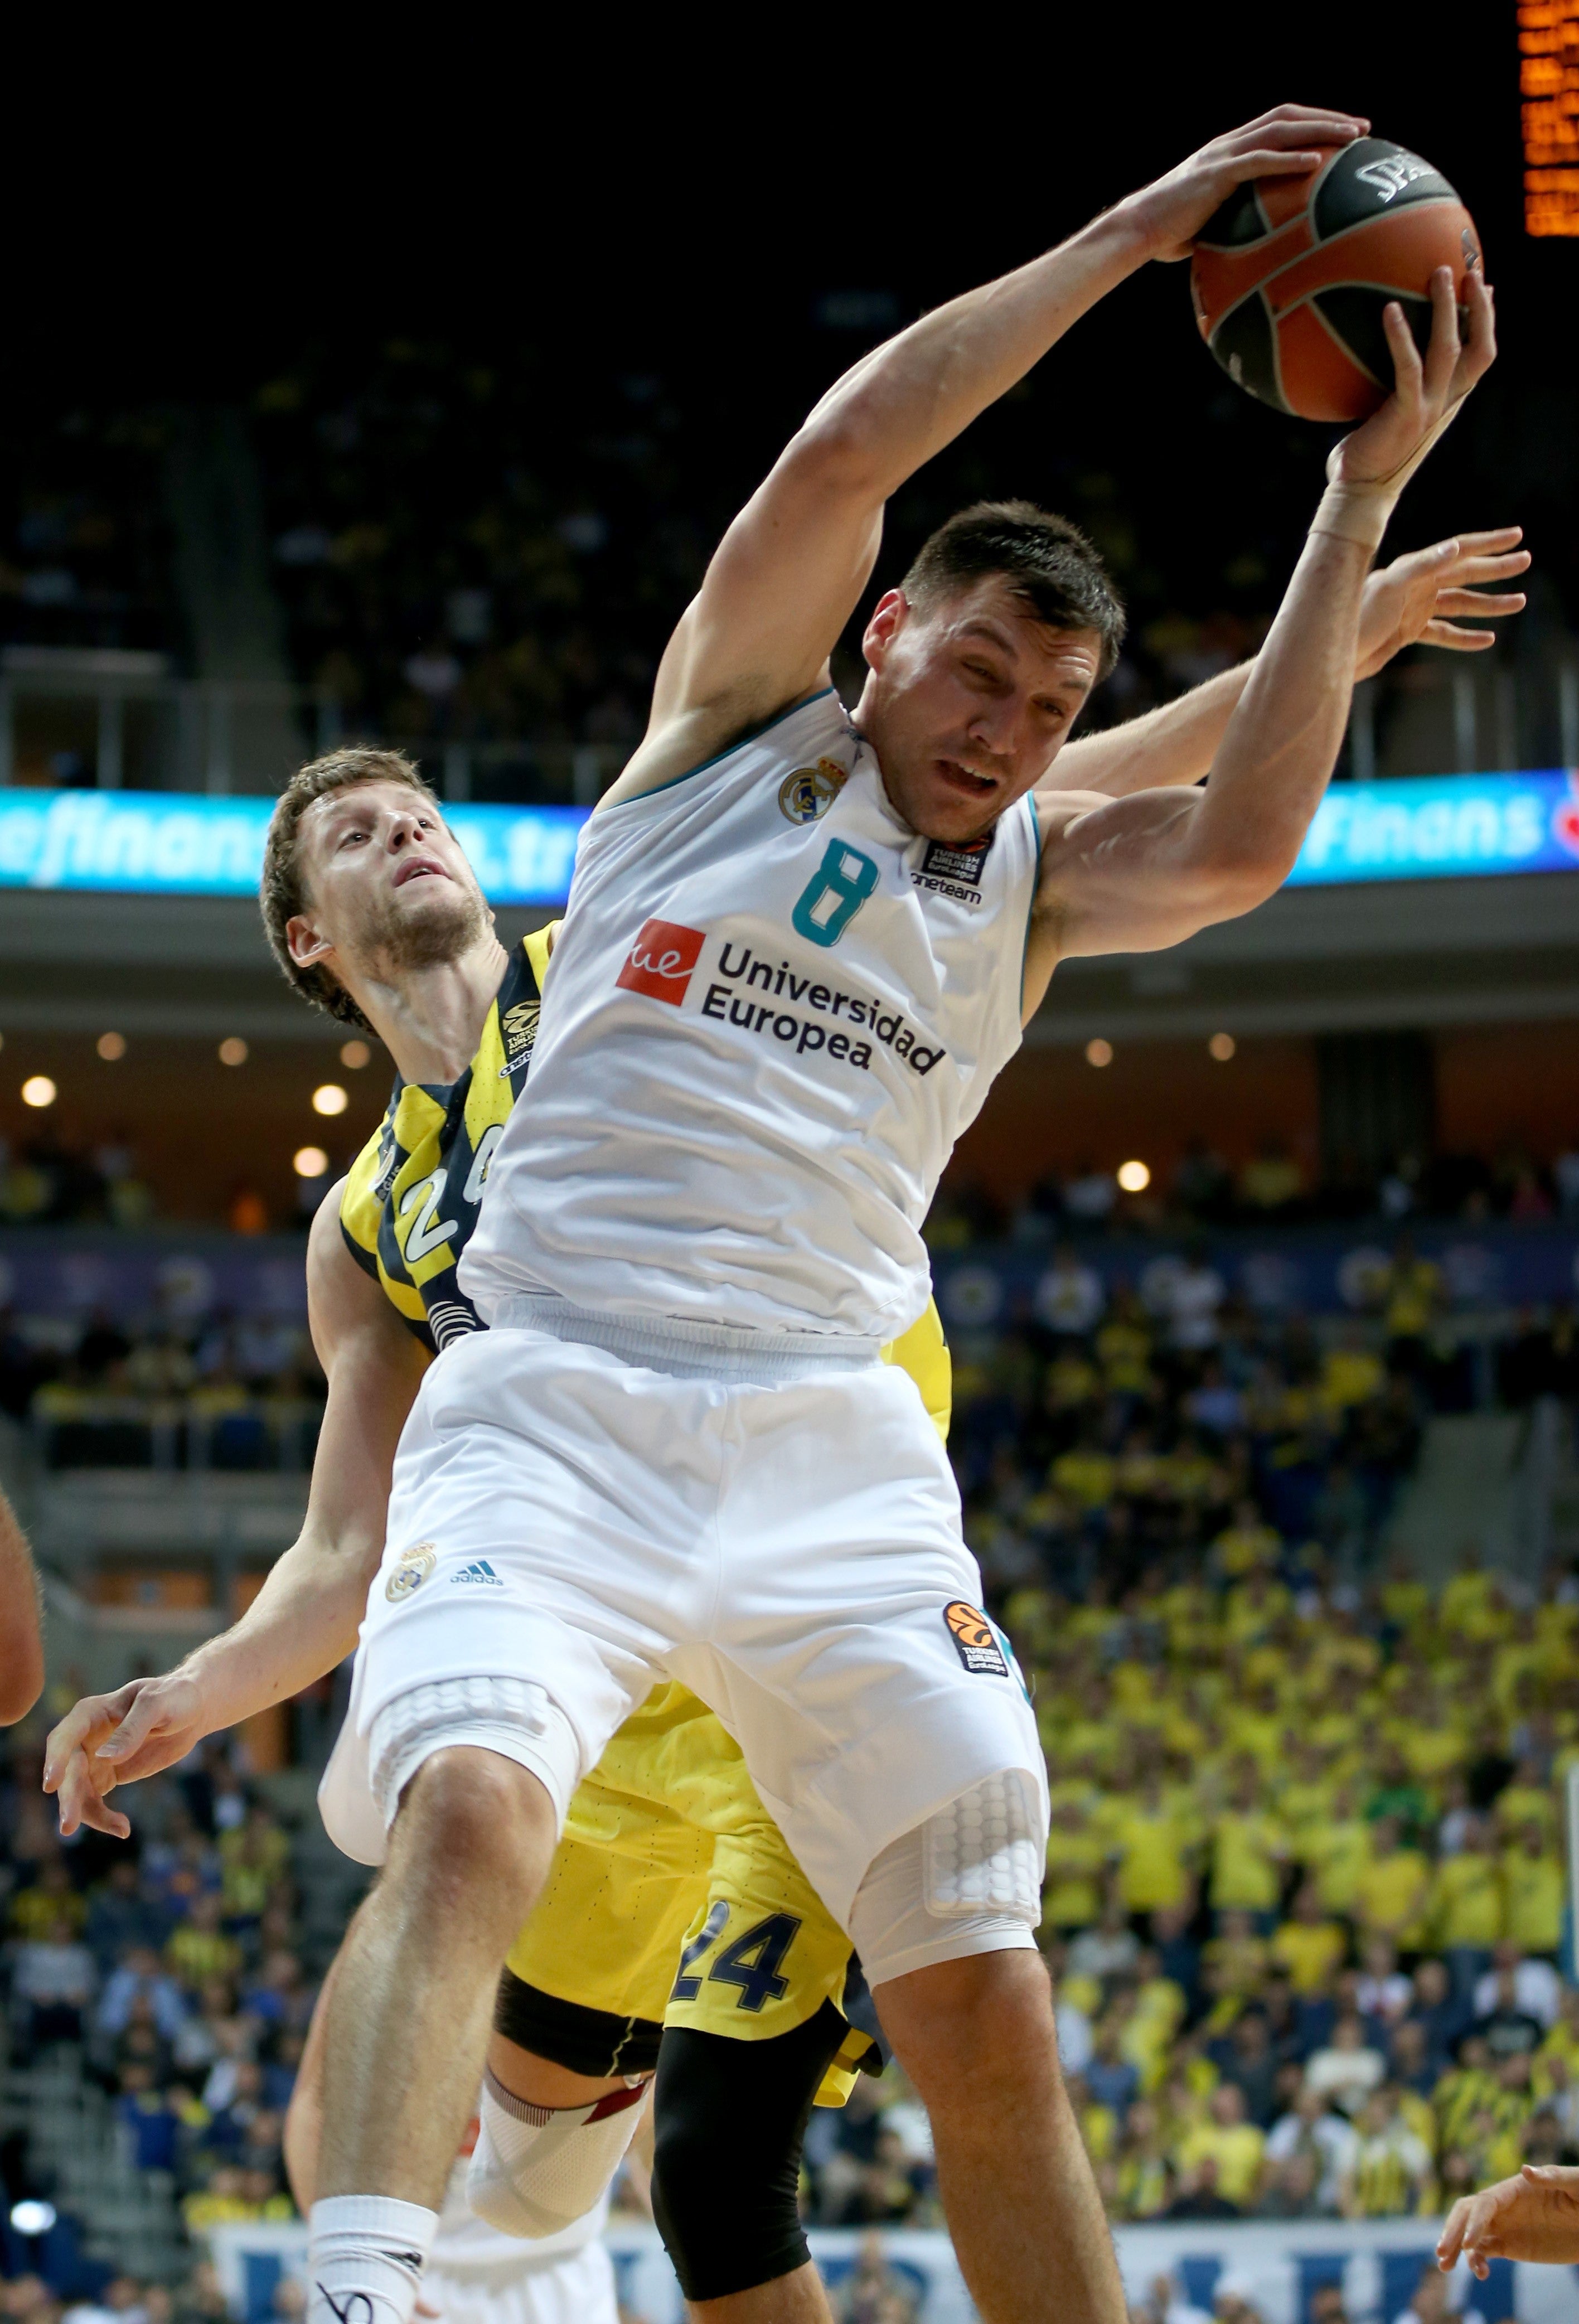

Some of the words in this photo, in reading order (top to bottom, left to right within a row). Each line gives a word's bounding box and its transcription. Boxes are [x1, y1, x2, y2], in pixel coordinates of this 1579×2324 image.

[792, 837, 880, 947] 8
[701, 984, 873, 1071] Europea
[718, 943, 946, 1076] Universidad
[670, 1900, 802, 2012] 24
